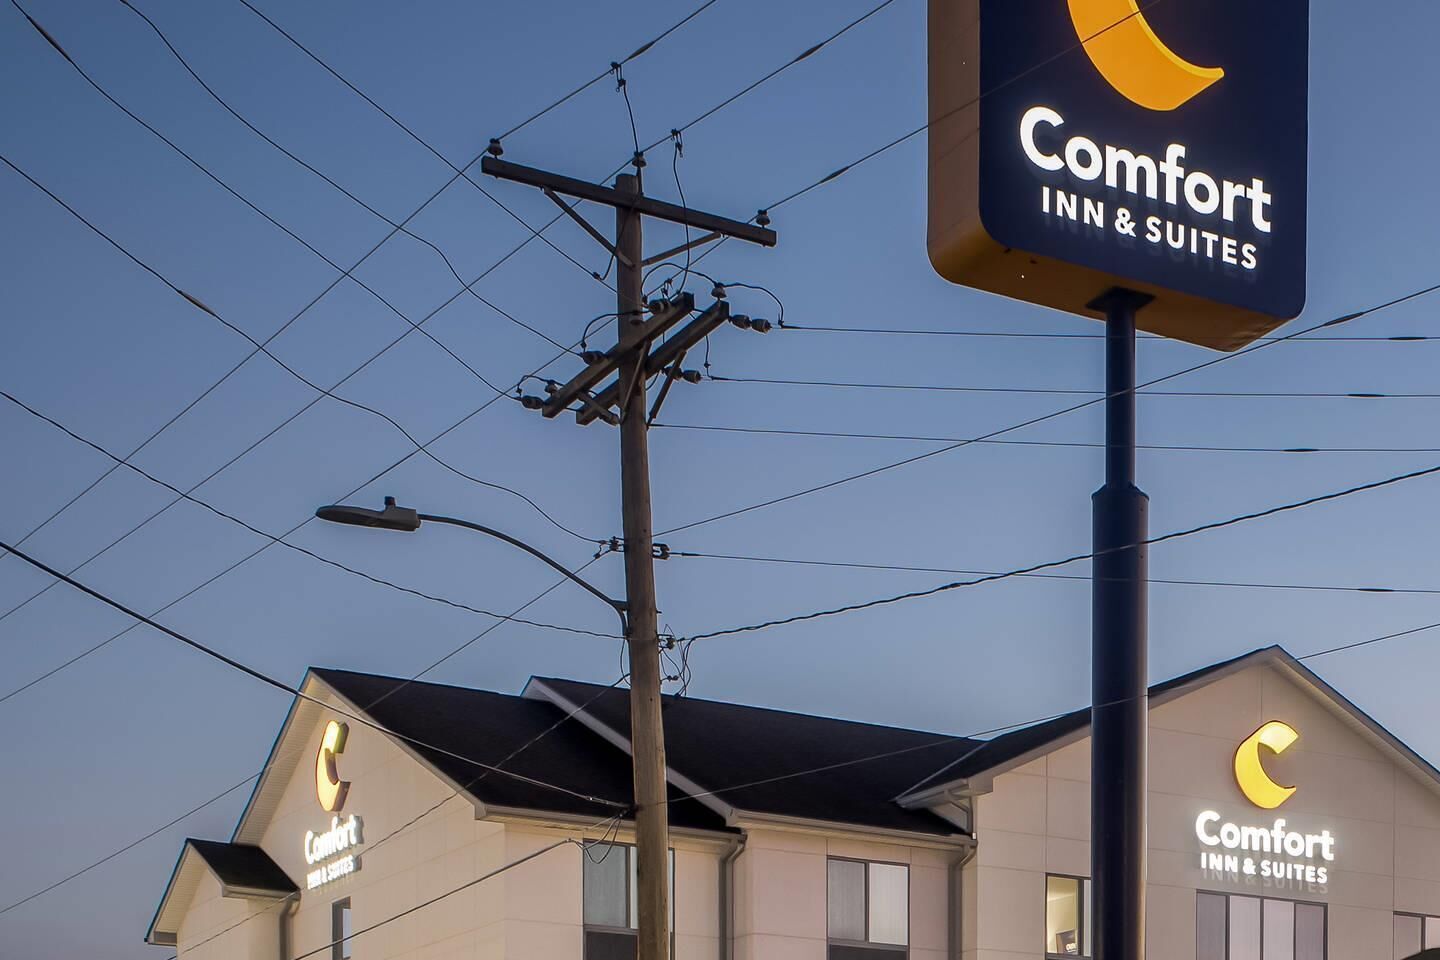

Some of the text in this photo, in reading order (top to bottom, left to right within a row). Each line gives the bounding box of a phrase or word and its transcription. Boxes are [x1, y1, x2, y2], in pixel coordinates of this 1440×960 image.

[1019, 106, 1272, 233] Comfort
[1042, 186, 1258, 270] INN & SUITES
[305, 814, 357, 865] Comfort
[1195, 810, 1335, 861] Comfort
[1201, 852, 1328, 884] INN & SUITES
